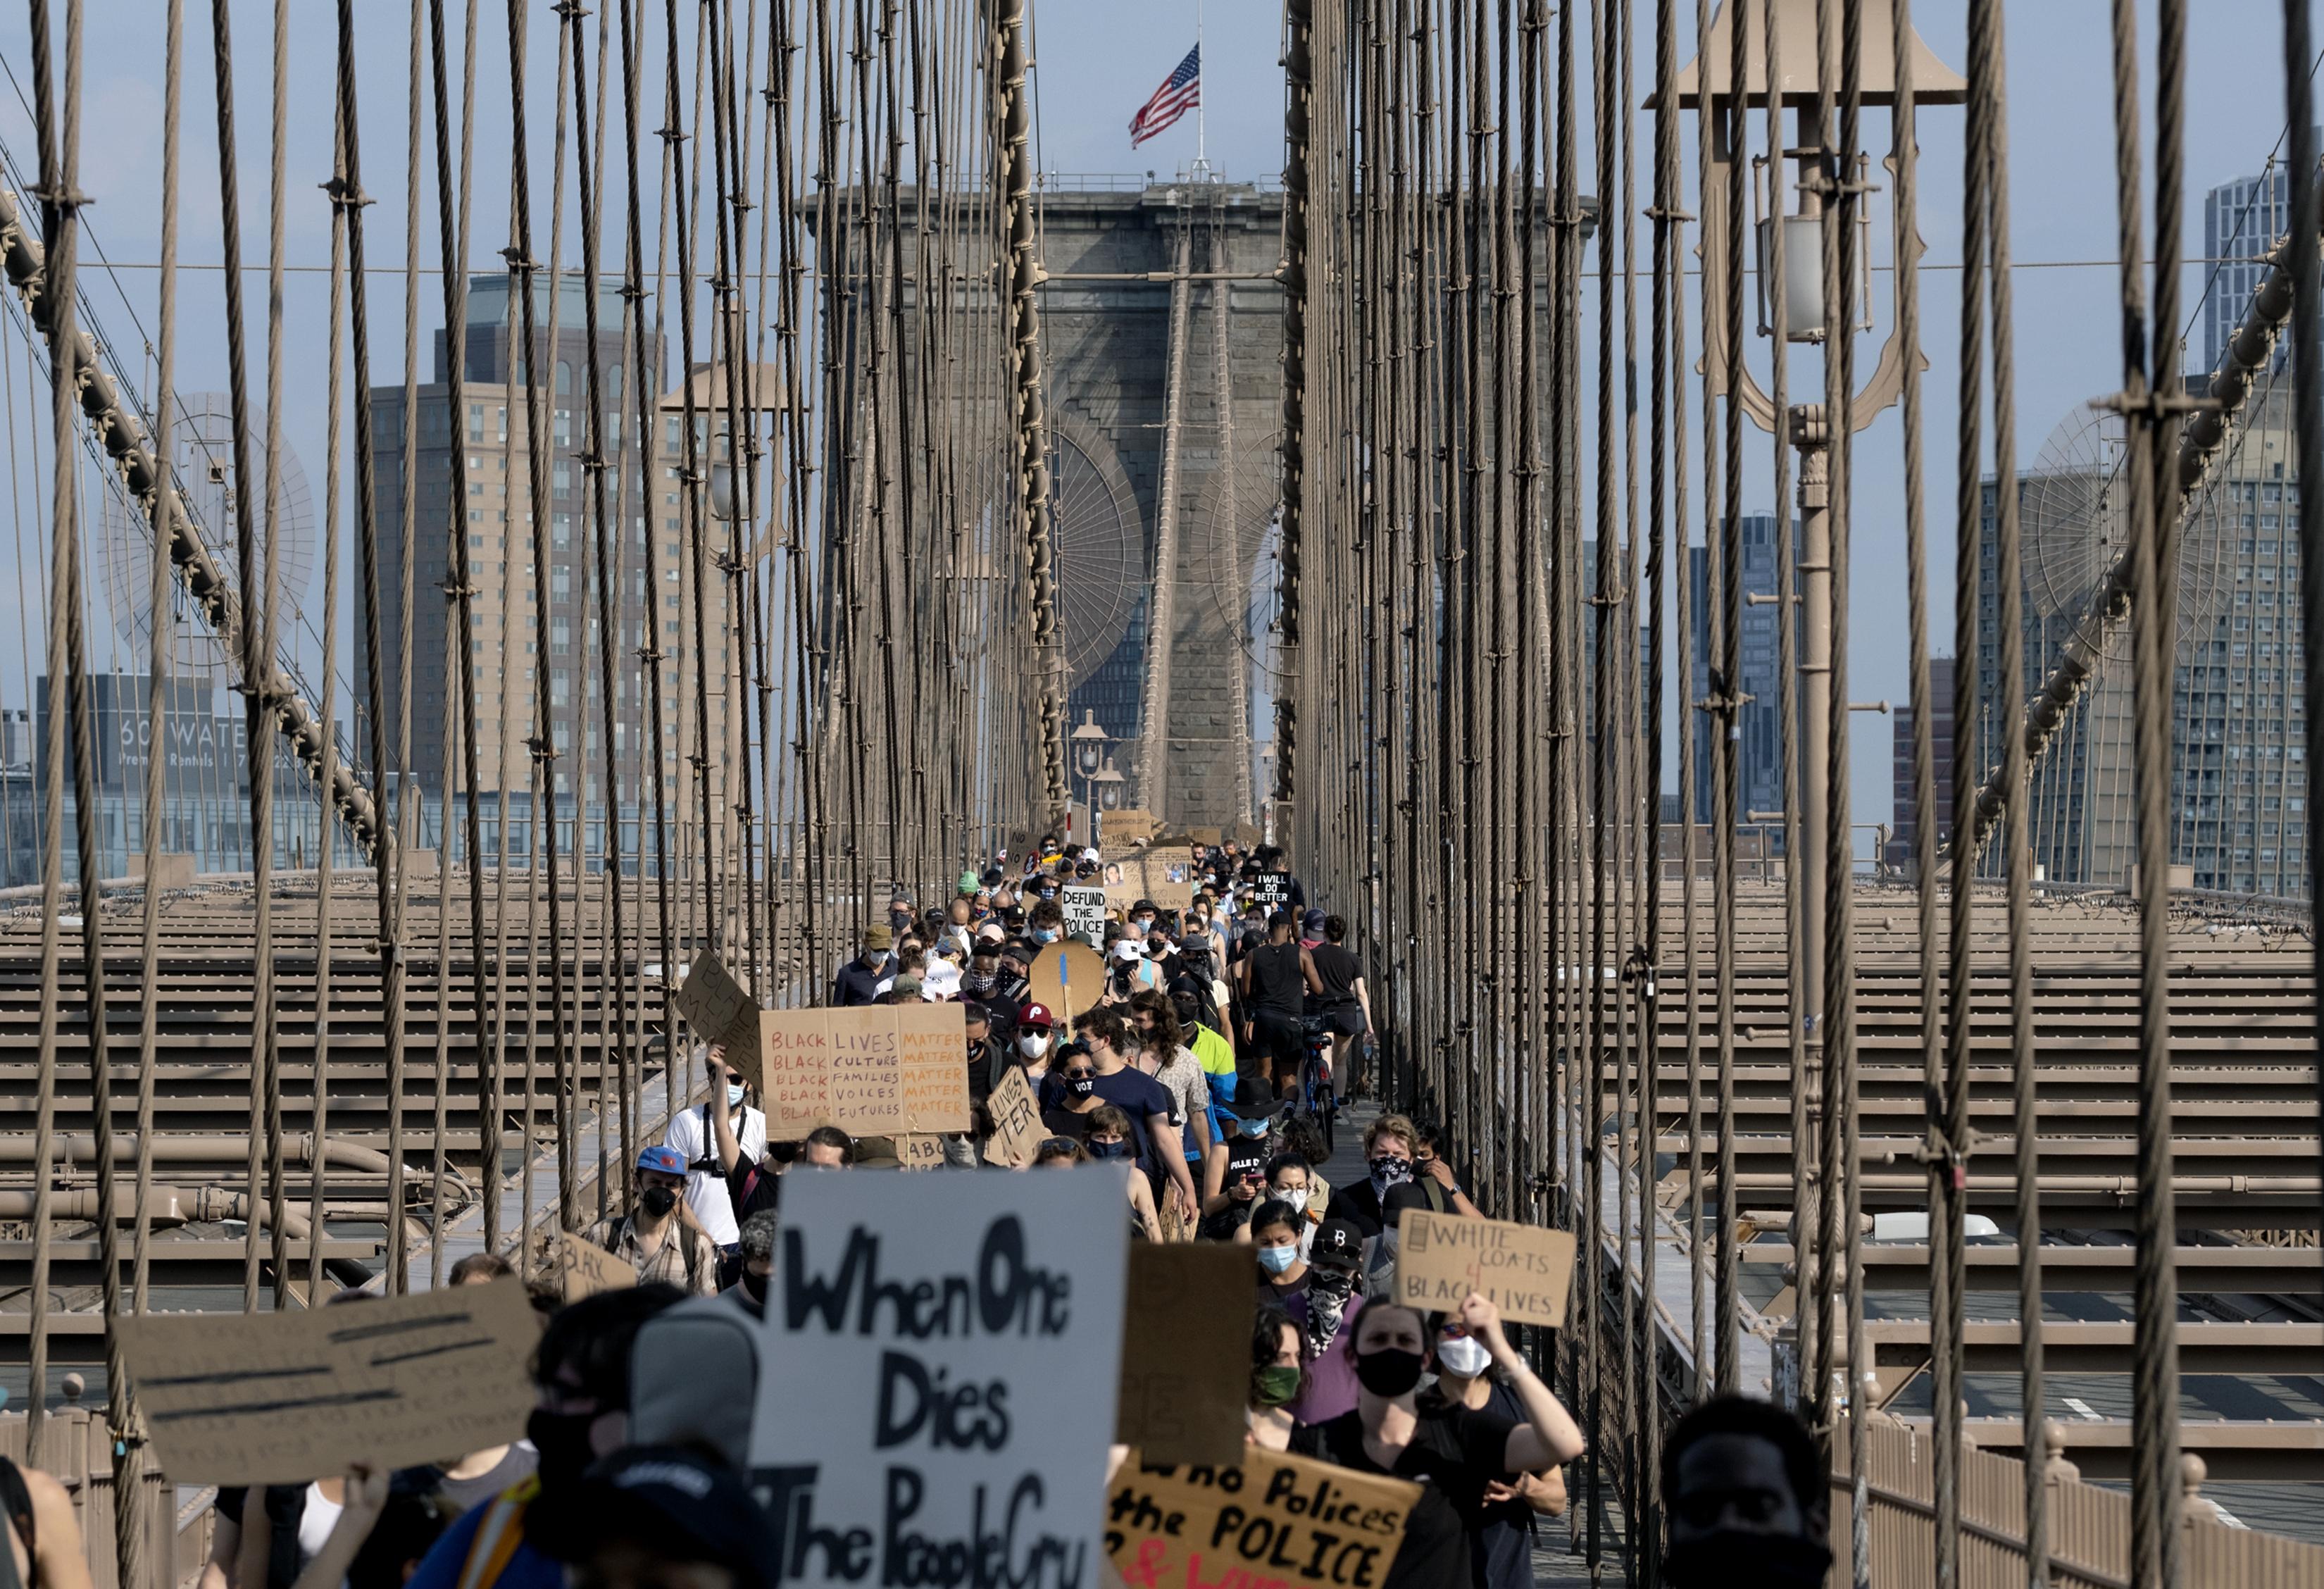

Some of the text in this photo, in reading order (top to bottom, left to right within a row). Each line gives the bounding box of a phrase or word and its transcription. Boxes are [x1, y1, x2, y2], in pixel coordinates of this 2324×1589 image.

[121, 720, 245, 748] 60 WATE
[170, 752, 213, 766] Rentals
[1012, 832, 1025, 843] NO
[1008, 852, 1020, 864] NO
[1258, 875, 1287, 884] I WILL
[1265, 884, 1277, 893] DO
[1063, 891, 1105, 906] DEFUND
[1255, 892, 1289, 902] BETTER
[1073, 908, 1093, 918] THE
[1064, 918, 1103, 933] POLICE
[1029, 1006, 1042, 1019] P
[771, 1031, 963, 1052] BLACK LIVES MATTER
[774, 1055, 827, 1071] BLACK
[833, 1056, 898, 1068] CULTURE
[902, 1051, 963, 1064] MATTERS
[777, 1067, 963, 1088] BLACK FAMILIES MATTER
[1075, 1081, 1092, 1092] VOTE
[780, 1085, 963, 1102] BLACK VOICES MATTER
[781, 1099, 963, 1121] BLACK FUTURES MATTER
[1335, 1229, 1346, 1247] B
[1432, 1221, 1512, 1249] WHITE
[1480, 1249, 1549, 1274] COATS
[783, 1223, 972, 1339] When
[977, 1213, 1072, 1338] One
[1466, 1263, 1481, 1289] 4
[1489, 1288, 1552, 1315] LIVES
[873, 1349, 1011, 1452] Dies
[1264, 1466, 1400, 1535] Polices
[749, 1464, 874, 1581] The
[1109, 1488, 1187, 1537] the
[1210, 1505, 1383, 1589] POLICE
